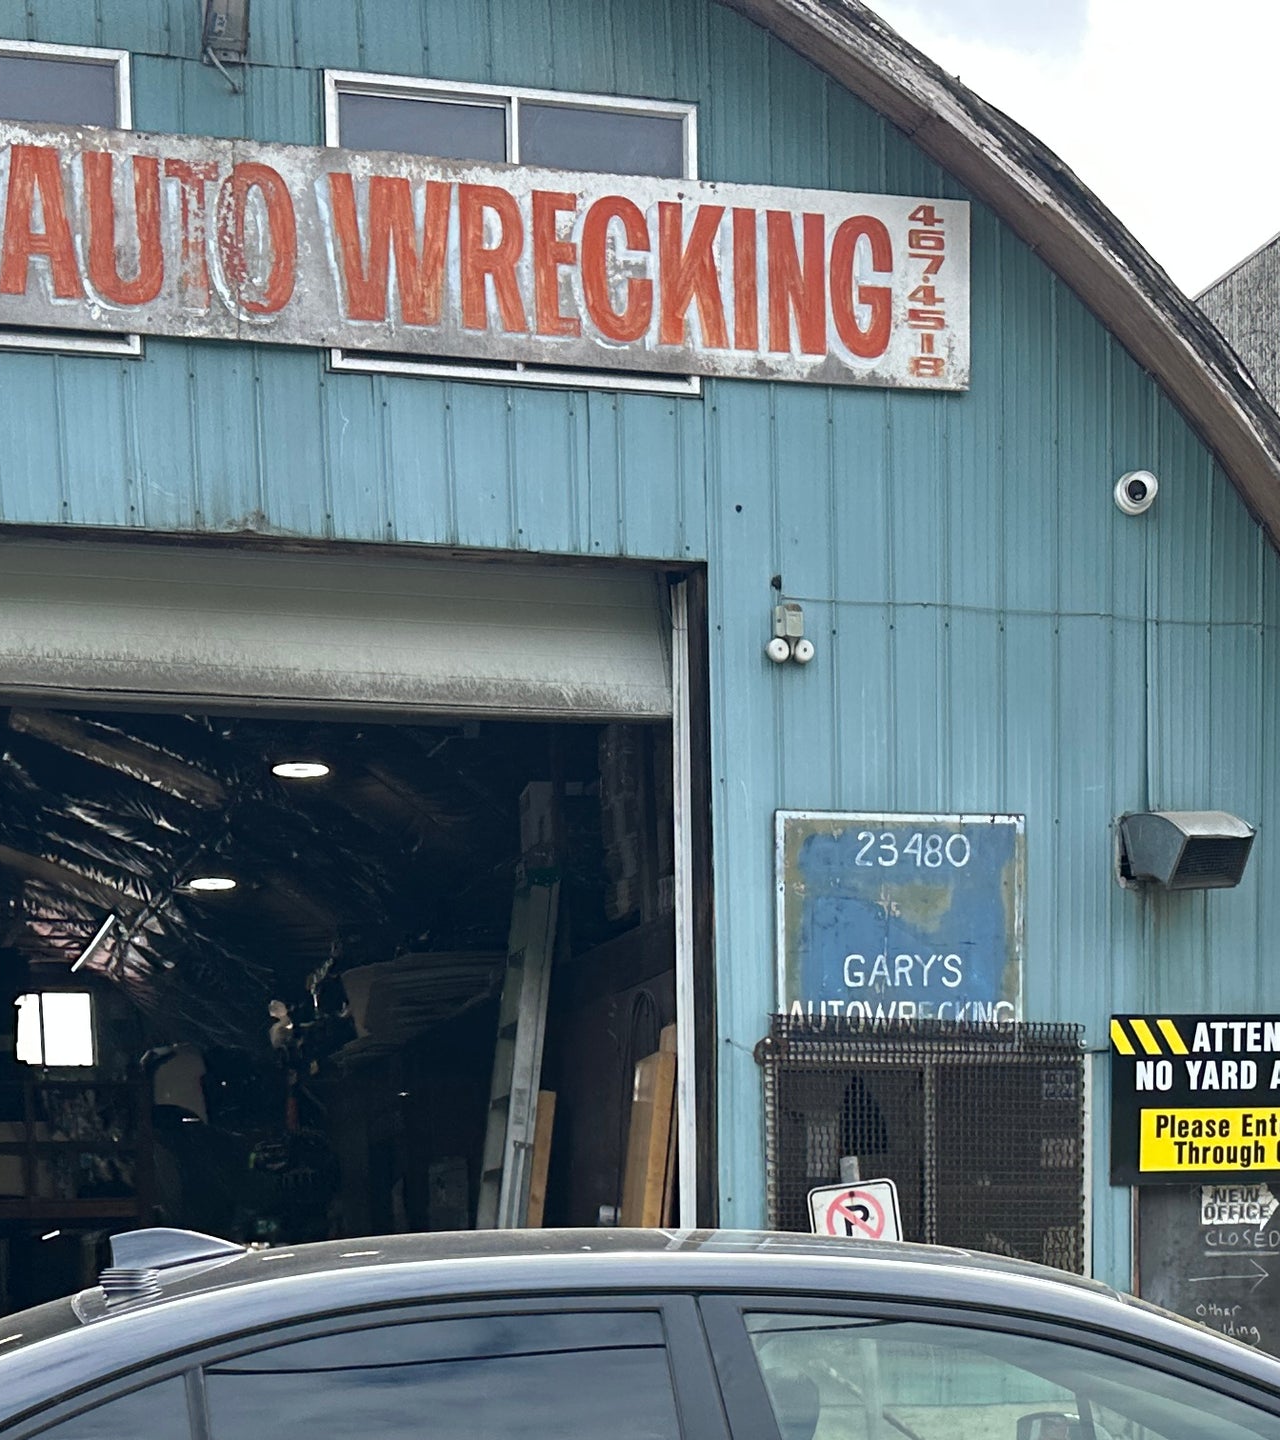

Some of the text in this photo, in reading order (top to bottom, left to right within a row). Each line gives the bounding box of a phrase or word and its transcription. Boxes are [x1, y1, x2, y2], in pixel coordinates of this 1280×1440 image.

[0, 144, 298, 315] AUTO
[329, 172, 893, 359] WRECKING
[854, 831, 971, 868] 23480
[843, 953, 962, 988] GARY'S
[1135, 1060, 1173, 1091] NO
[1185, 1060, 1257, 1090] YARD
[1155, 1114, 1230, 1138] Please
[1173, 1141, 1265, 1168] Through
[1212, 1187, 1260, 1204] NEW
[1204, 1202, 1271, 1220] OFFICE
[1204, 1229, 1280, 1248] CLOSED
